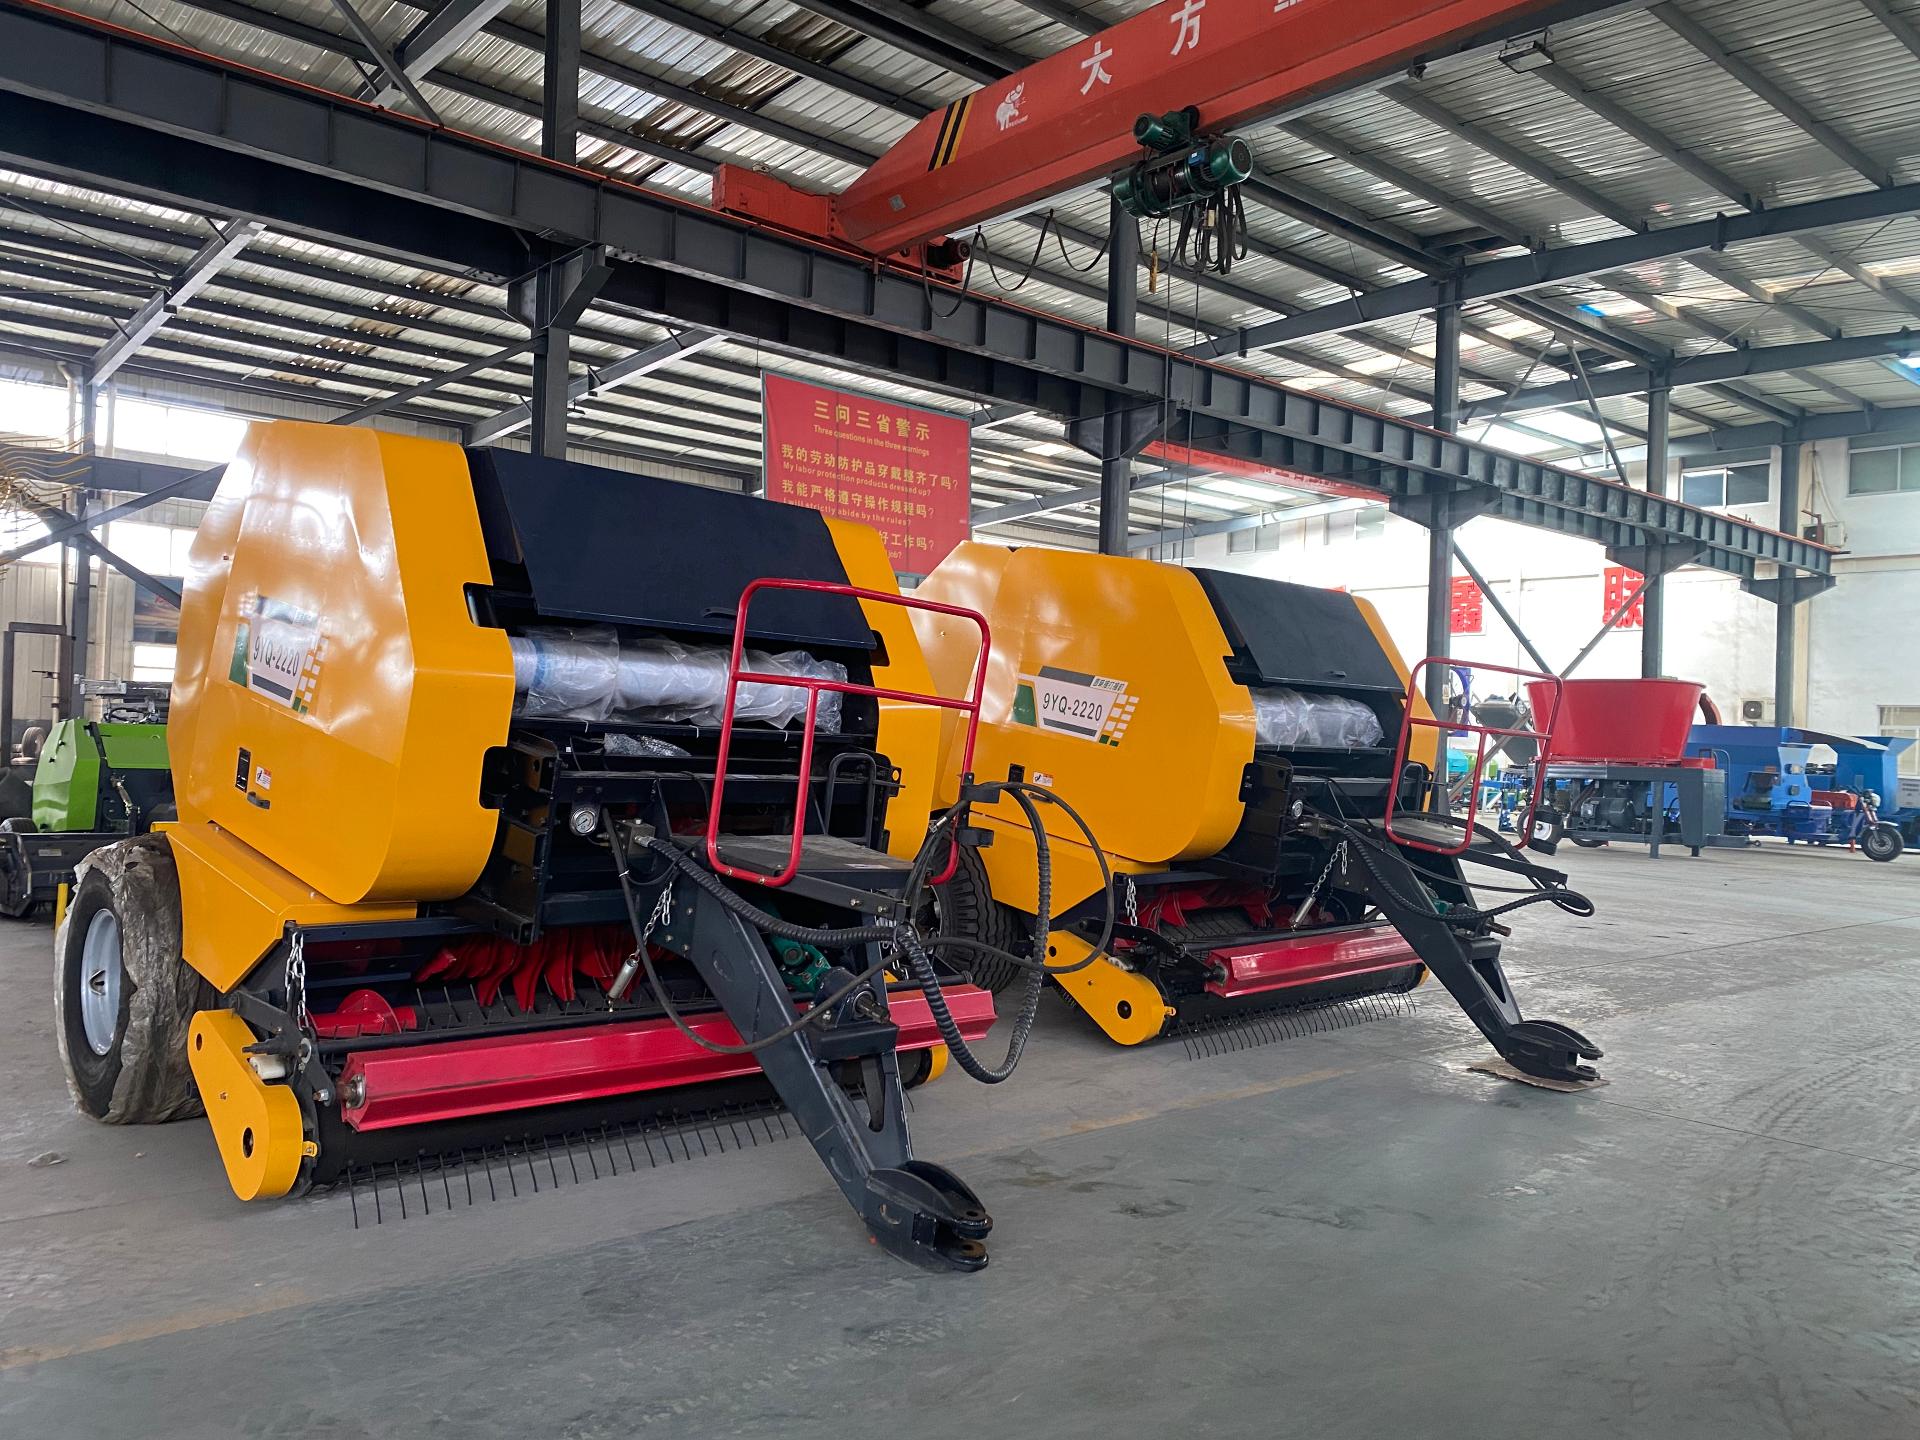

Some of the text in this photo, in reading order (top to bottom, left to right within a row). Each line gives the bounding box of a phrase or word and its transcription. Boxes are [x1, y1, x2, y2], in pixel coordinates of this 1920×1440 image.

[1081, 0, 1300, 95] 大方
[813, 400, 930, 441] 三问三省警示
[813, 424, 930, 457] Three questions in the three warnings
[783, 461, 931, 497] My labor protection products dressed up?
[838, 509, 860, 518] abide
[861, 512, 871, 521] by
[872, 514, 885, 522] the
[886, 517, 911, 526] rules?
[253, 636, 300, 677] 9YQ-2220
[1043, 692, 1103, 721] 9YQ-2220
